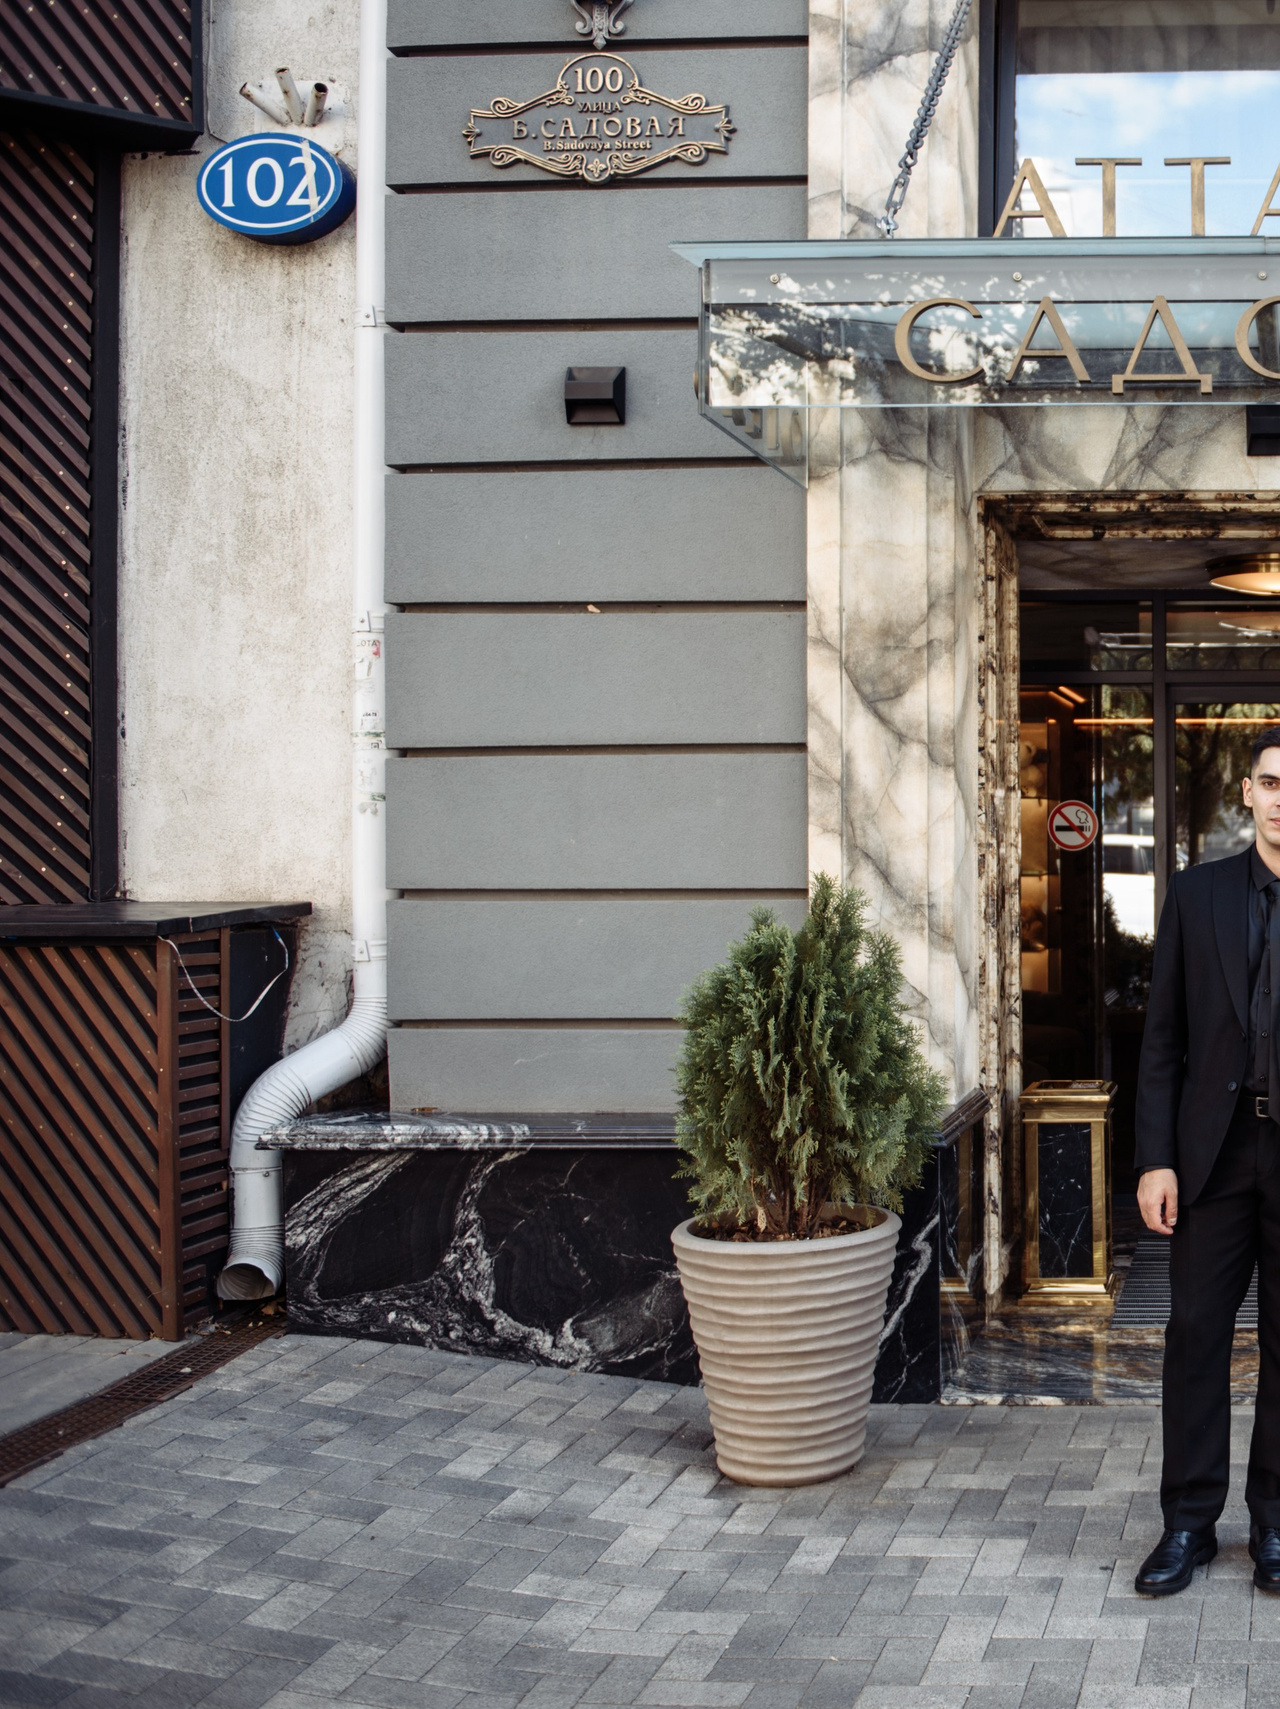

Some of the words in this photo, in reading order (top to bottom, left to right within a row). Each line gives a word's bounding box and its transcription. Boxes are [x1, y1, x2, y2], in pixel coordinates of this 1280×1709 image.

[574, 66, 624, 94] 100
[577, 101, 623, 114] УЛИЦА
[614, 140, 653, 151] Street
[218, 156, 321, 208] 102
